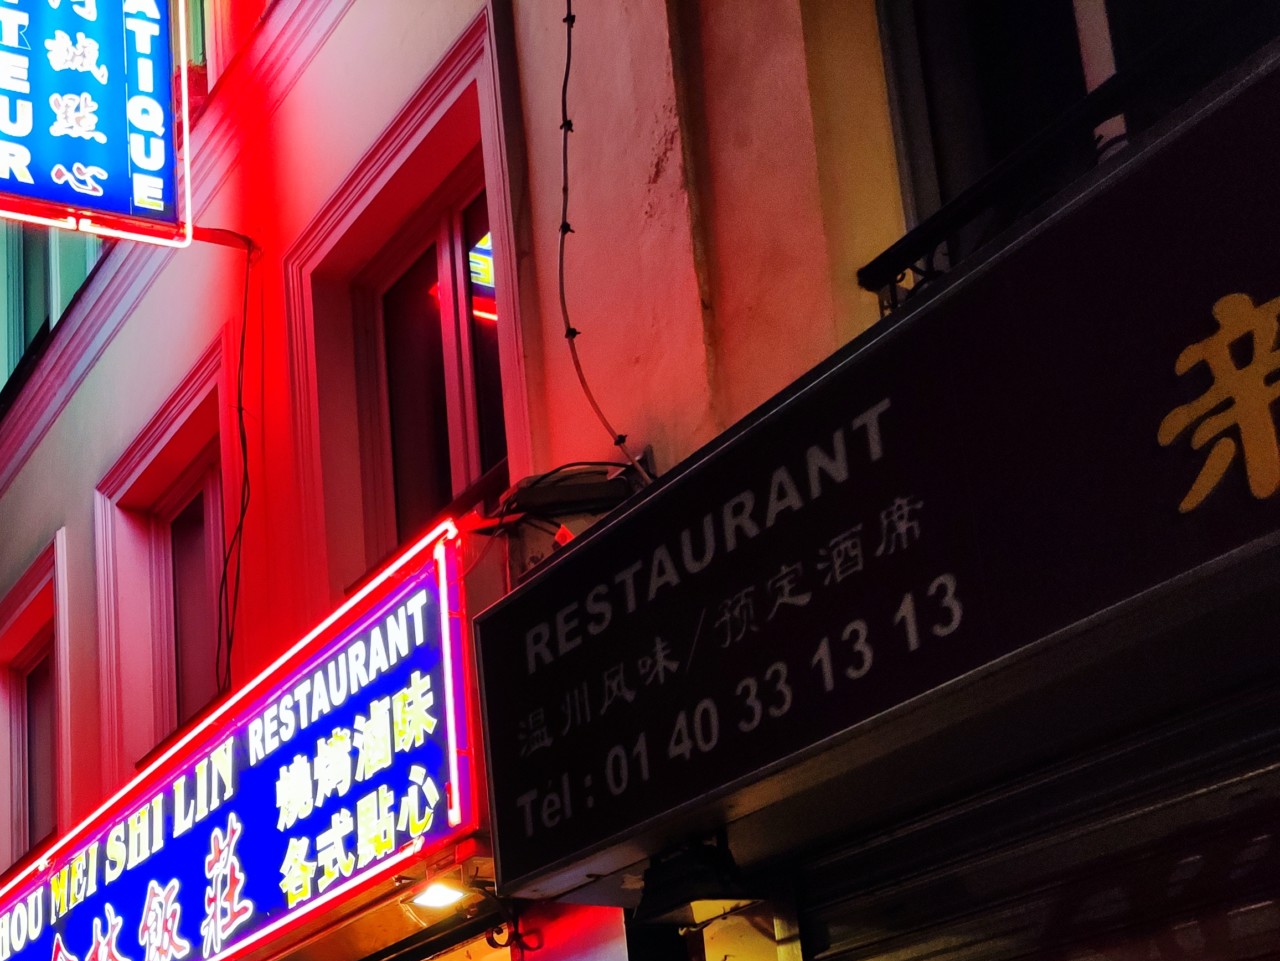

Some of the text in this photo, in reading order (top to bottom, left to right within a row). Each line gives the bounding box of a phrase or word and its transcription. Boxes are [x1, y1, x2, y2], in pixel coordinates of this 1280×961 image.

[525, 397, 892, 676] RESTAURANT
[50, 841, 100, 926] MEI
[105, 792, 164, 886] SHI
[172, 737, 235, 838] LIN
[247, 590, 430, 767] RESTAURANT
[604, 730, 650, 798] 01
[666, 697, 721, 764] 40
[736, 660, 795, 734] 33
[811, 619, 874, 693] 13
[892, 572, 965, 654] 13
